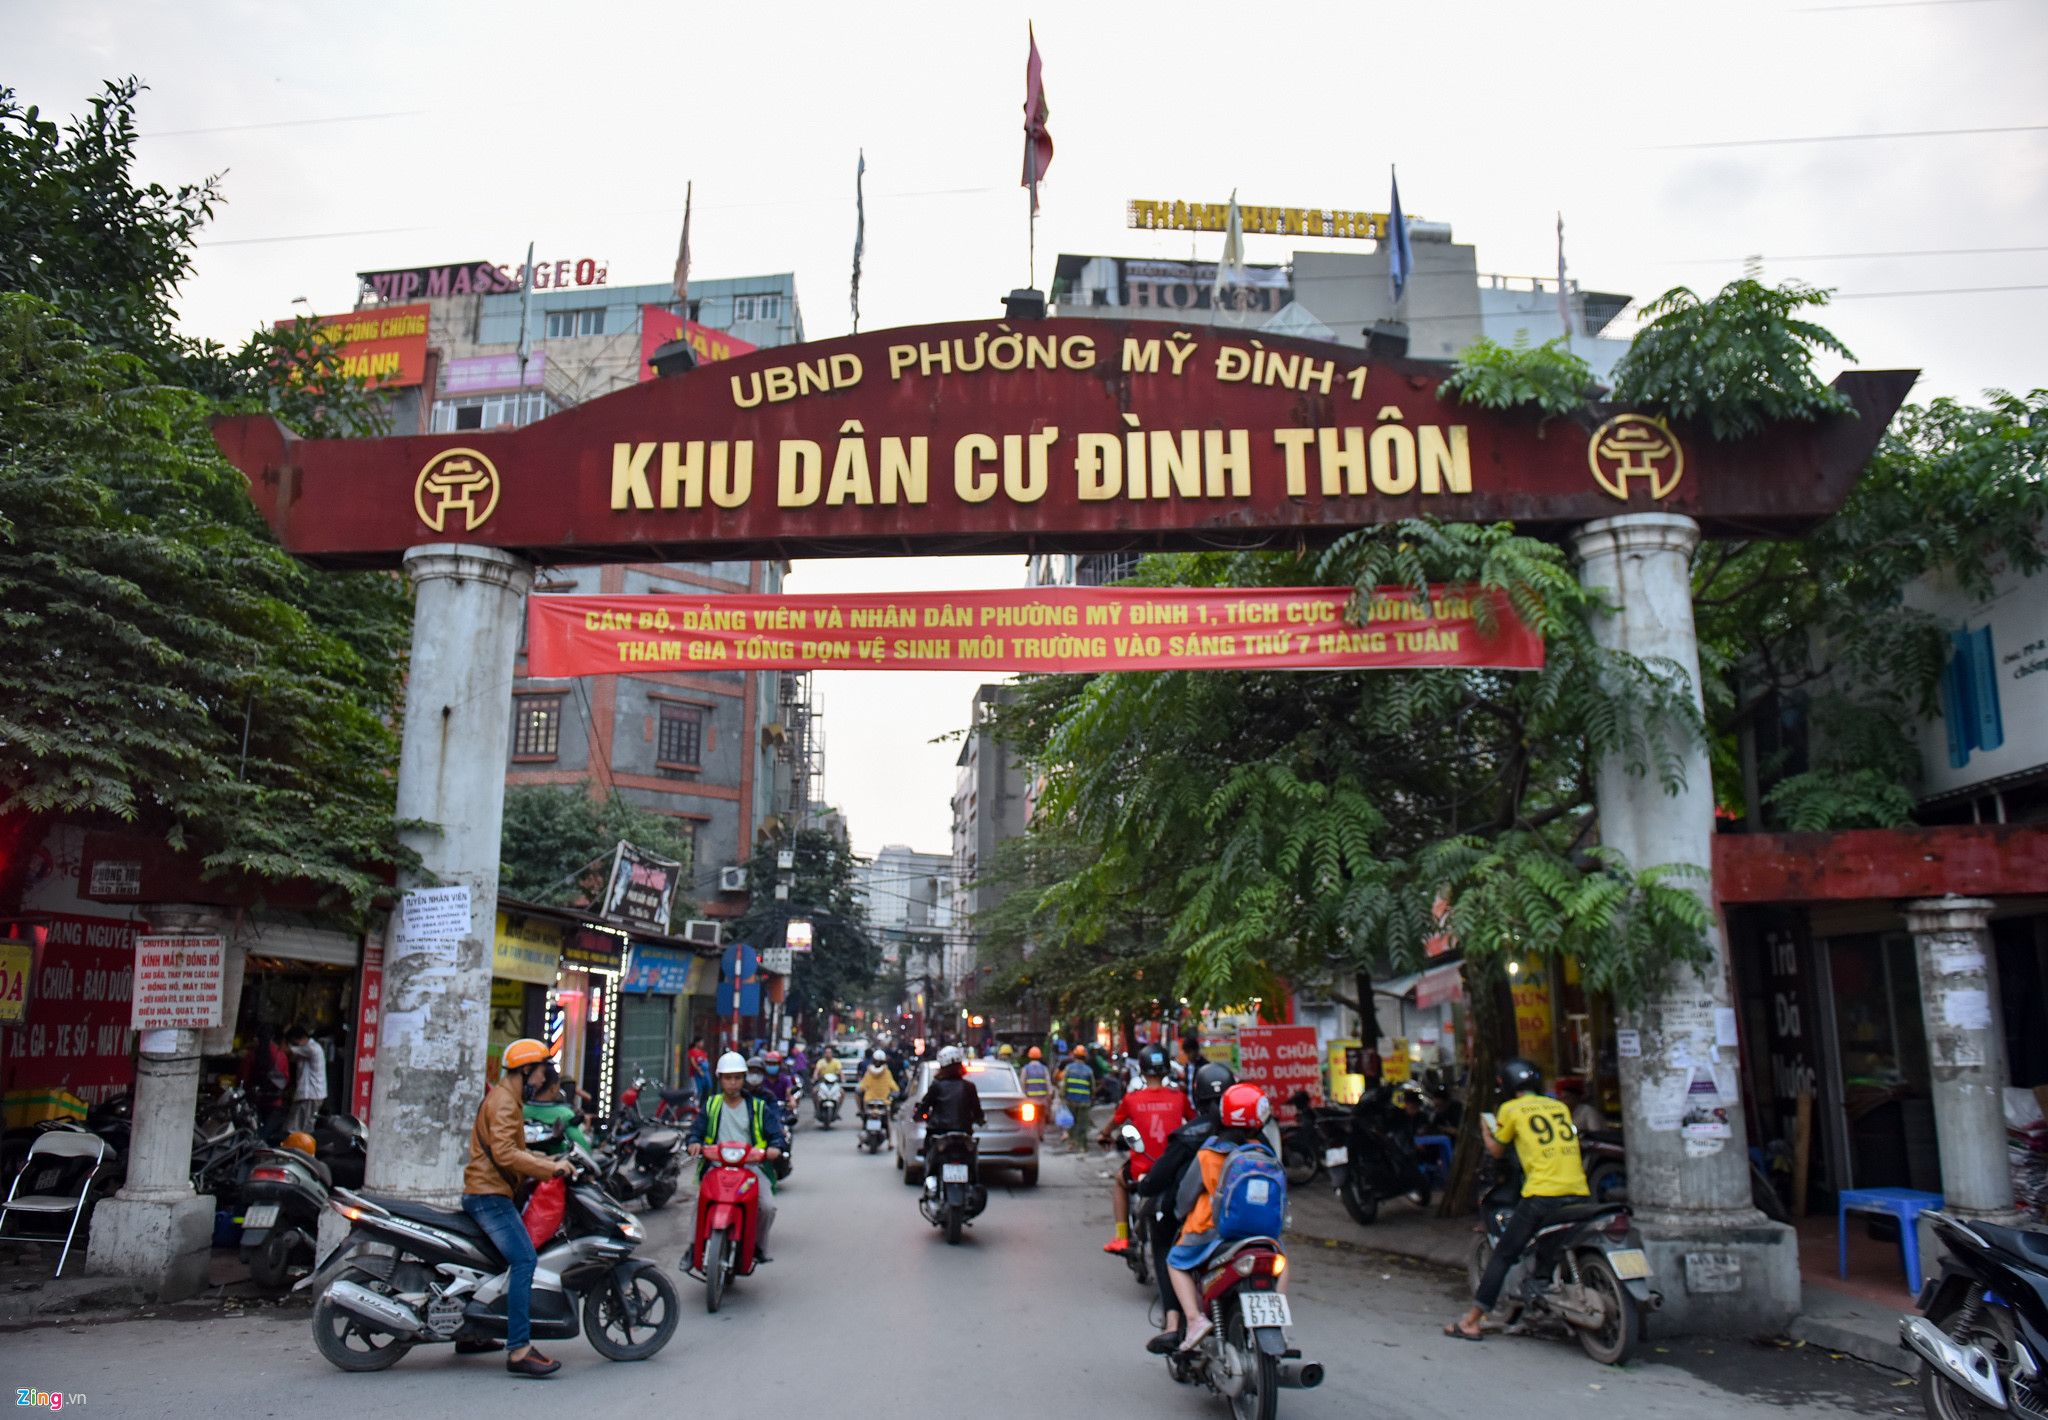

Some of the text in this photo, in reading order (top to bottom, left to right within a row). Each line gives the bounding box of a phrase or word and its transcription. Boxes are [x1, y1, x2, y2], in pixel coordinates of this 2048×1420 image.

[371, 272, 418, 299] VIP
[426, 259, 571, 297] MASSAGE
[381, 311, 427, 339] CHỨNG
[730, 323, 1369, 408] UBND PHƯỜNG MỸ ĐÌNH 1
[610, 406, 1473, 510] KHU DÂN CƯ ĐÌNH THÔN
[585, 608, 632, 632] CÁN
[638, 607, 676, 634] BỘ,
[683, 603, 746, 631] ĐẢNG
[753, 606, 806, 630] VIÊN
[814, 605, 844, 630] VÀ
[851, 604, 917, 629] NHÂN
[924, 604, 973, 628] DÂN
[980, 600, 1078, 627] PHƯỜNG
[1085, 601, 1123, 626] MỸ
[1129, 600, 1189, 625] ĐÌNH
[1196, 604, 1217, 626] 1,
[1224, 599, 1279, 624] TÍCH
[1286, 600, 1335, 626] CỰC
[617, 641, 681, 662] THAM
[688, 640, 727, 660] GIA
[734, 633, 795, 660] TỔNG
[802, 640, 851, 663] DỌN
[858, 635, 886, 662] VỆ
[893, 638, 951, 660] SINH
[958, 634, 1005, 659] MÔI
[1011, 632, 1107, 659] TRƯỜNG
[1114, 632, 1162, 657] VÀO
[1169, 631, 1235, 657] SÁNG
[1242, 629, 1293, 655] THỨ
[1296, 634, 1311, 654] 7
[1318, 630, 1387, 654] HÀNG
[141, 952, 161, 967] KÍNH
[30, 1023, 45, 1057] GA
[55, 1025, 71, 1057] XE
[97, 1017, 122, 1057] MÁY
[1240, 1041, 1319, 1060] SỬA CHỮA
[1149, 1114, 1165, 1143] 4
[1529, 1113, 1574, 1145] 93
[1251, 1309, 1286, 1325] 6739
